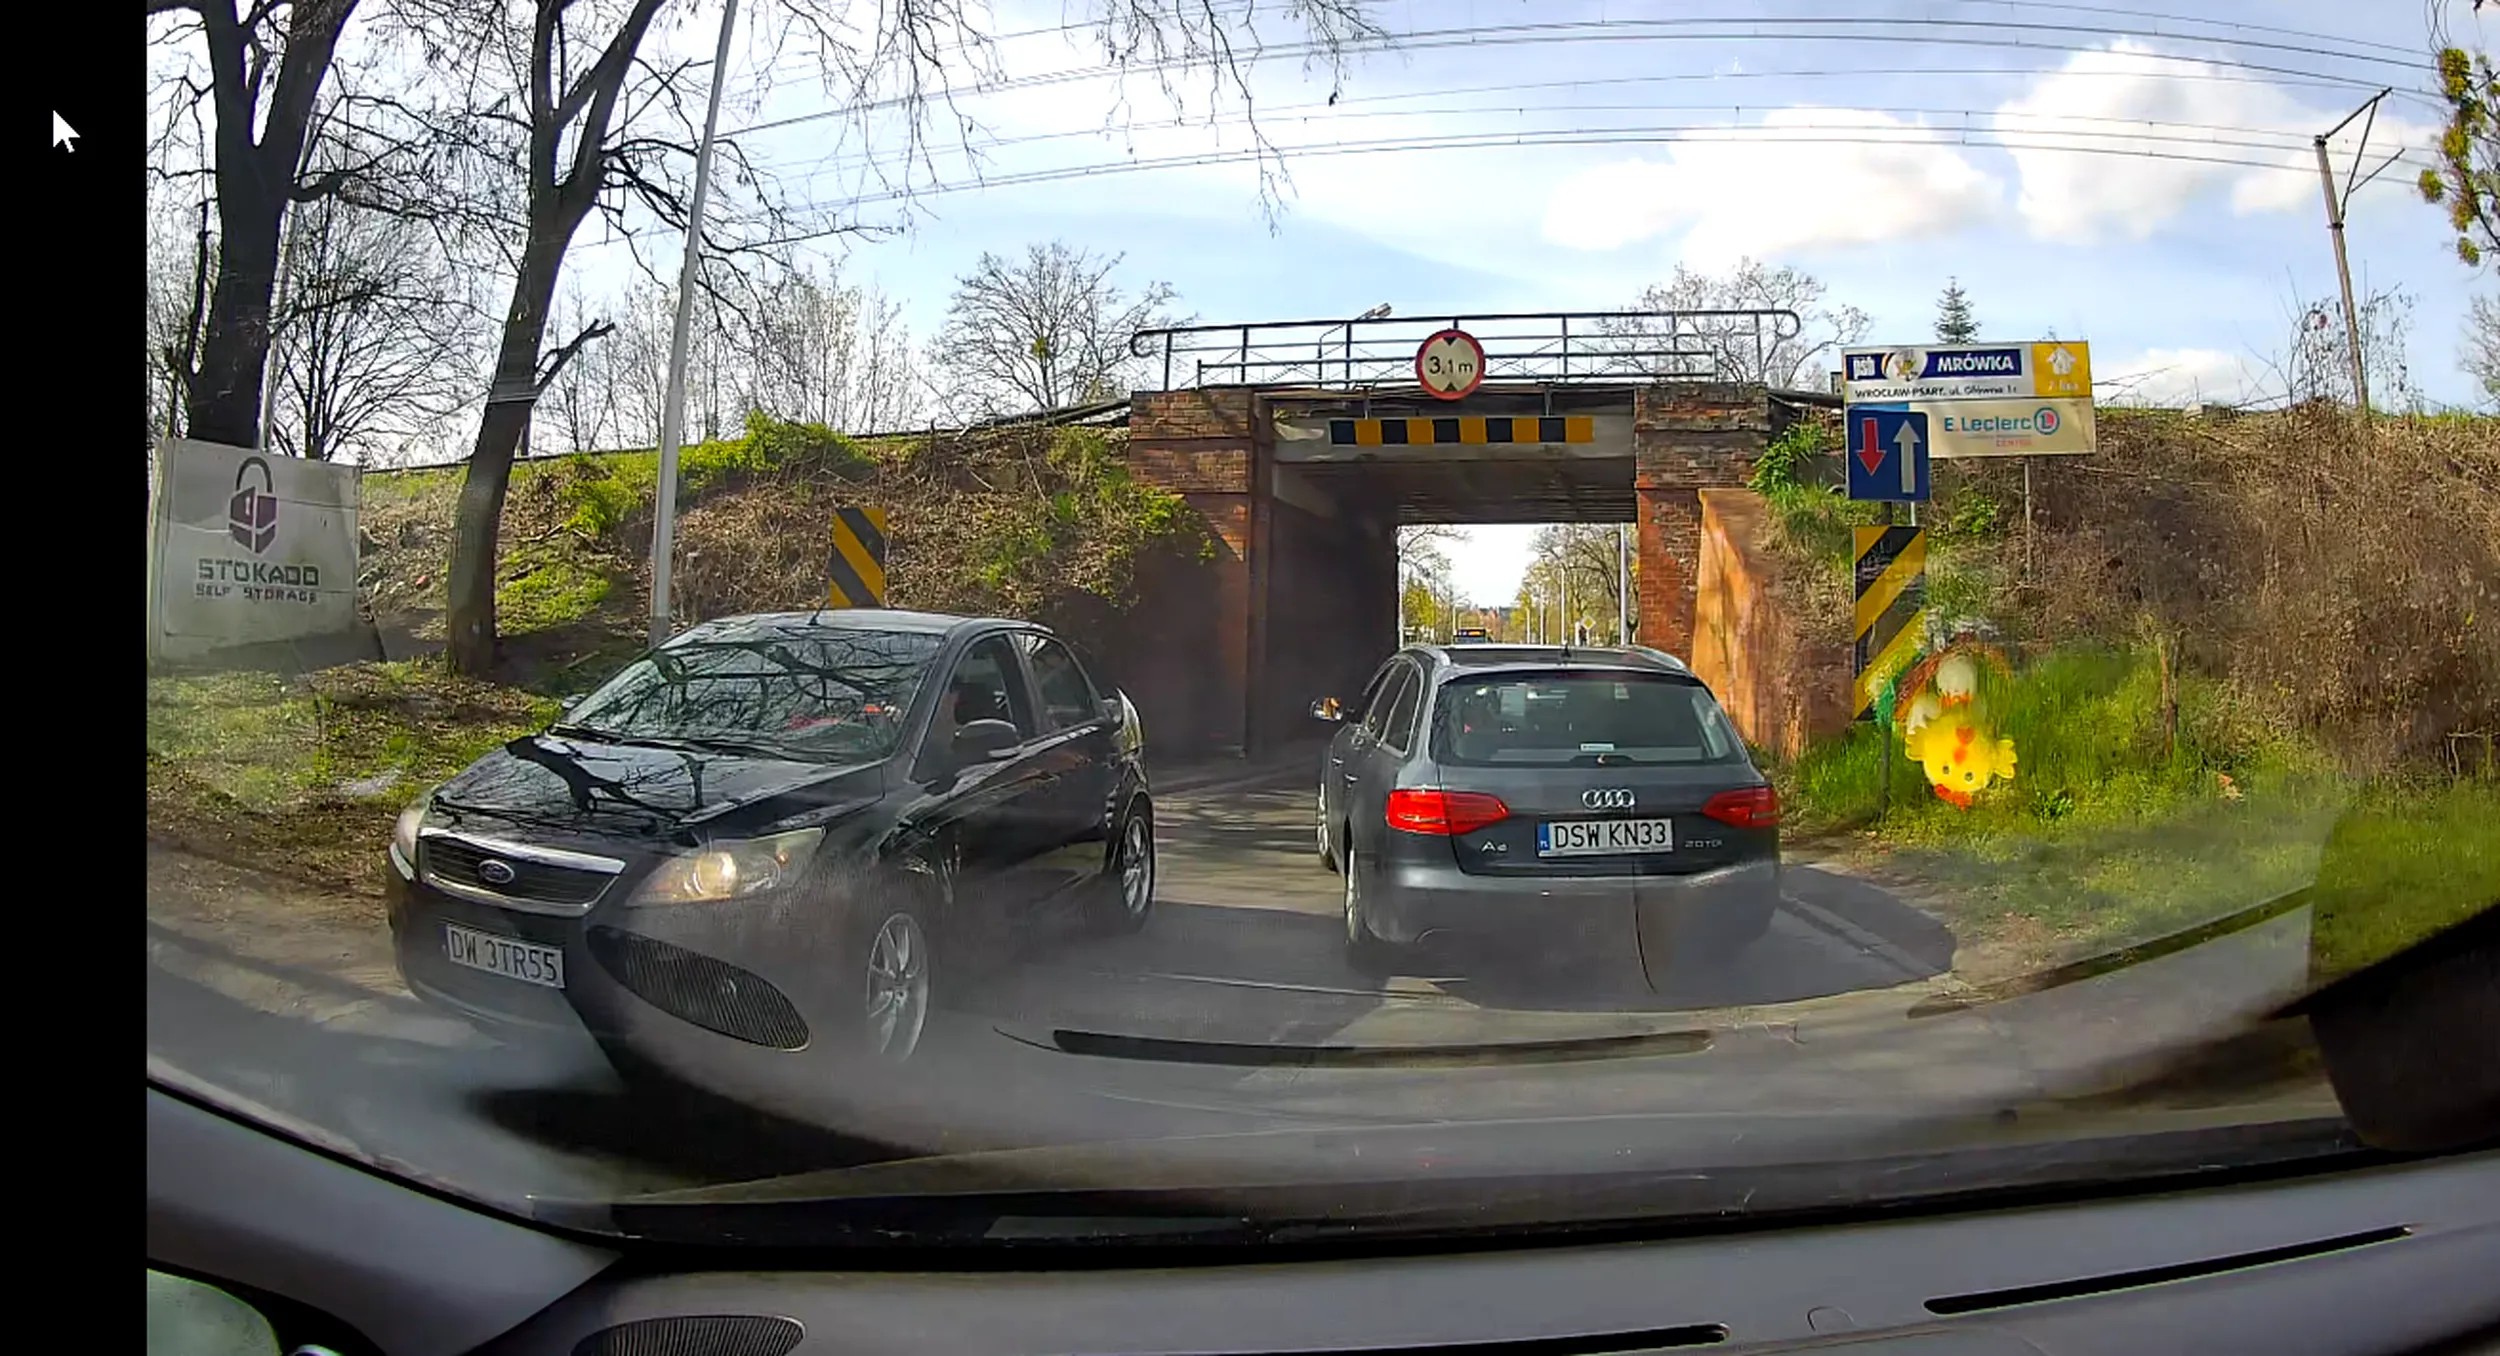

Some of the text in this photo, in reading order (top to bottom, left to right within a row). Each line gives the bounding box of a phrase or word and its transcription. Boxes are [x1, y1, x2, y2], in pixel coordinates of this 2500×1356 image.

[1458, 363, 1473, 373] m
[1937, 353, 2014, 372] MRÓWKA
[198, 558, 319, 586] STOKADO
[196, 583, 317, 604] SELF STORAGE
[1555, 822, 1666, 848] DSW KN33
[451, 929, 558, 982] DW 3TR55
